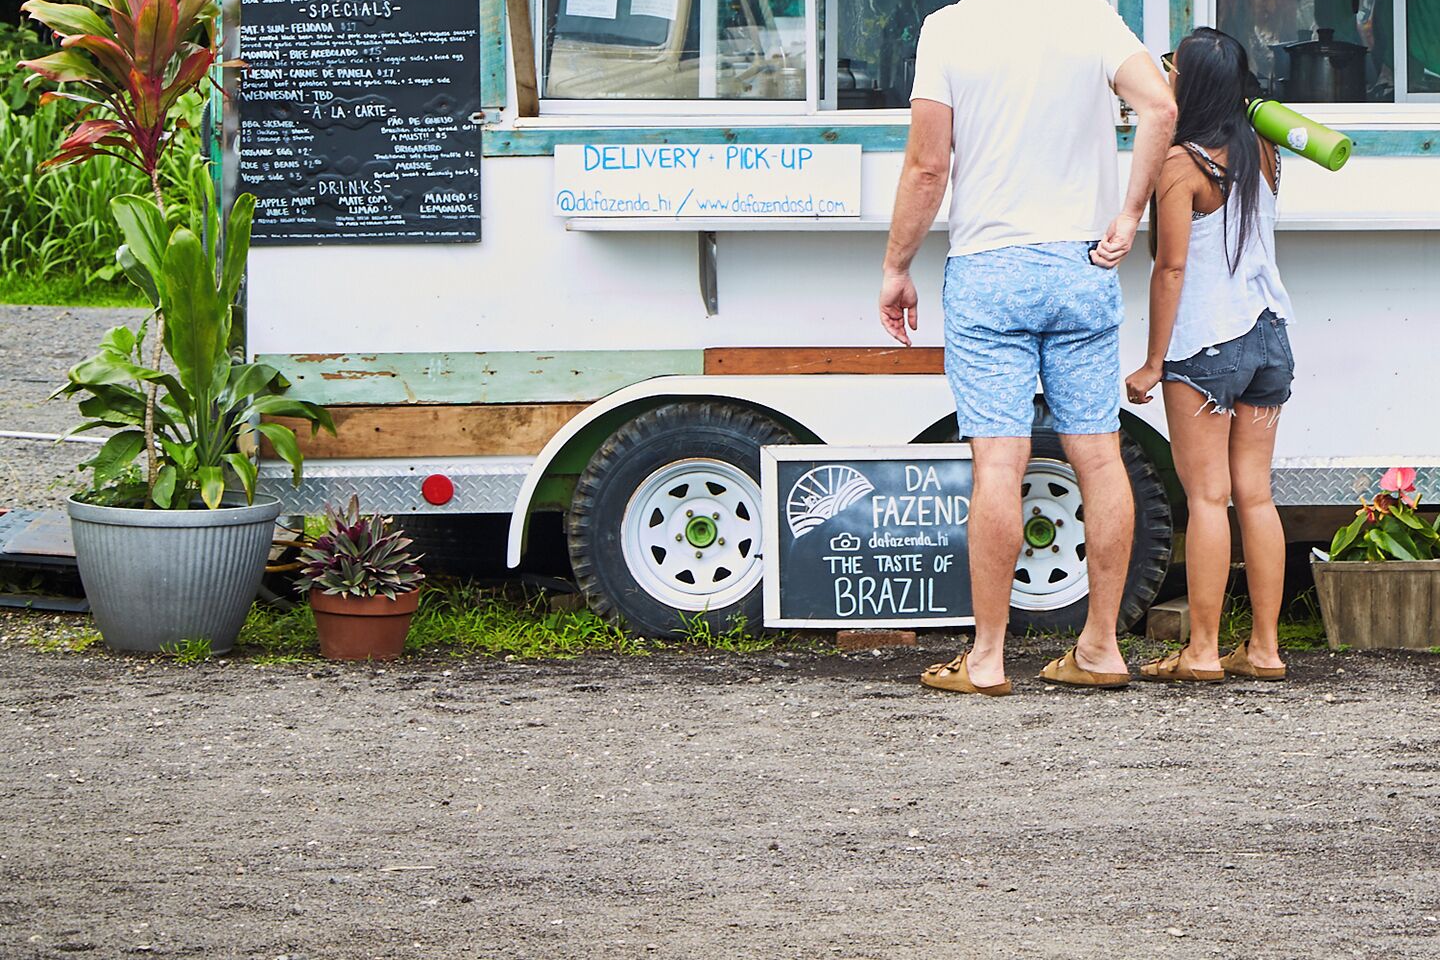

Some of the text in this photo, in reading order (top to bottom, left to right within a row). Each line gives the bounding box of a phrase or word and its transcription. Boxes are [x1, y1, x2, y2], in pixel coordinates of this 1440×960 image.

[291, 22, 335, 33] FEIJOADA
[240, 50, 280, 60] MONDAY
[289, 49, 310, 60] BIFE
[310, 48, 359, 59] ACEBOLADO
[240, 68, 283, 80] TUESDAY
[289, 68, 319, 78] CARNE
[322, 69, 335, 78] DE
[337, 68, 374, 79] PANELA
[241, 90, 334, 102] WEDNESDAY TBD
[331, 105, 346, 119] LA
[355, 104, 387, 118] CARTE
[242, 120, 261, 128] BBQ
[387, 115, 404, 126] PÃO
[408, 117, 421, 126] DE
[399, 132, 429, 141] MUST!!
[241, 149, 274, 157] ORGANIC
[276, 148, 293, 156] EGG
[394, 144, 442, 154] BRIGADEIRO
[584, 145, 701, 171] DELIVERY
[725, 146, 813, 170] PICK-UP
[241, 161, 259, 170] RICE
[273, 161, 300, 169] BEANS
[395, 162, 433, 171] MOUSSE
[241, 172, 303, 184] Veggie side $3
[255, 196, 316, 209] EAPPLE MINT
[338, 195, 388, 206] MATE COM
[424, 193, 479, 203] MANGO $5
[556, 190, 672, 217] @dafazenda_hi
[266, 208, 290, 217] JUICE
[349, 204, 380, 214] LIMÃO
[419, 204, 475, 214] LEMONADE
[905, 465, 942, 493] DA
[872, 495, 971, 529] FAZEND
[868, 531, 950, 550] dafazenda_hi
[822, 554, 954, 575] THE TASTE OF
[834, 576, 948, 618] BRAZIL
